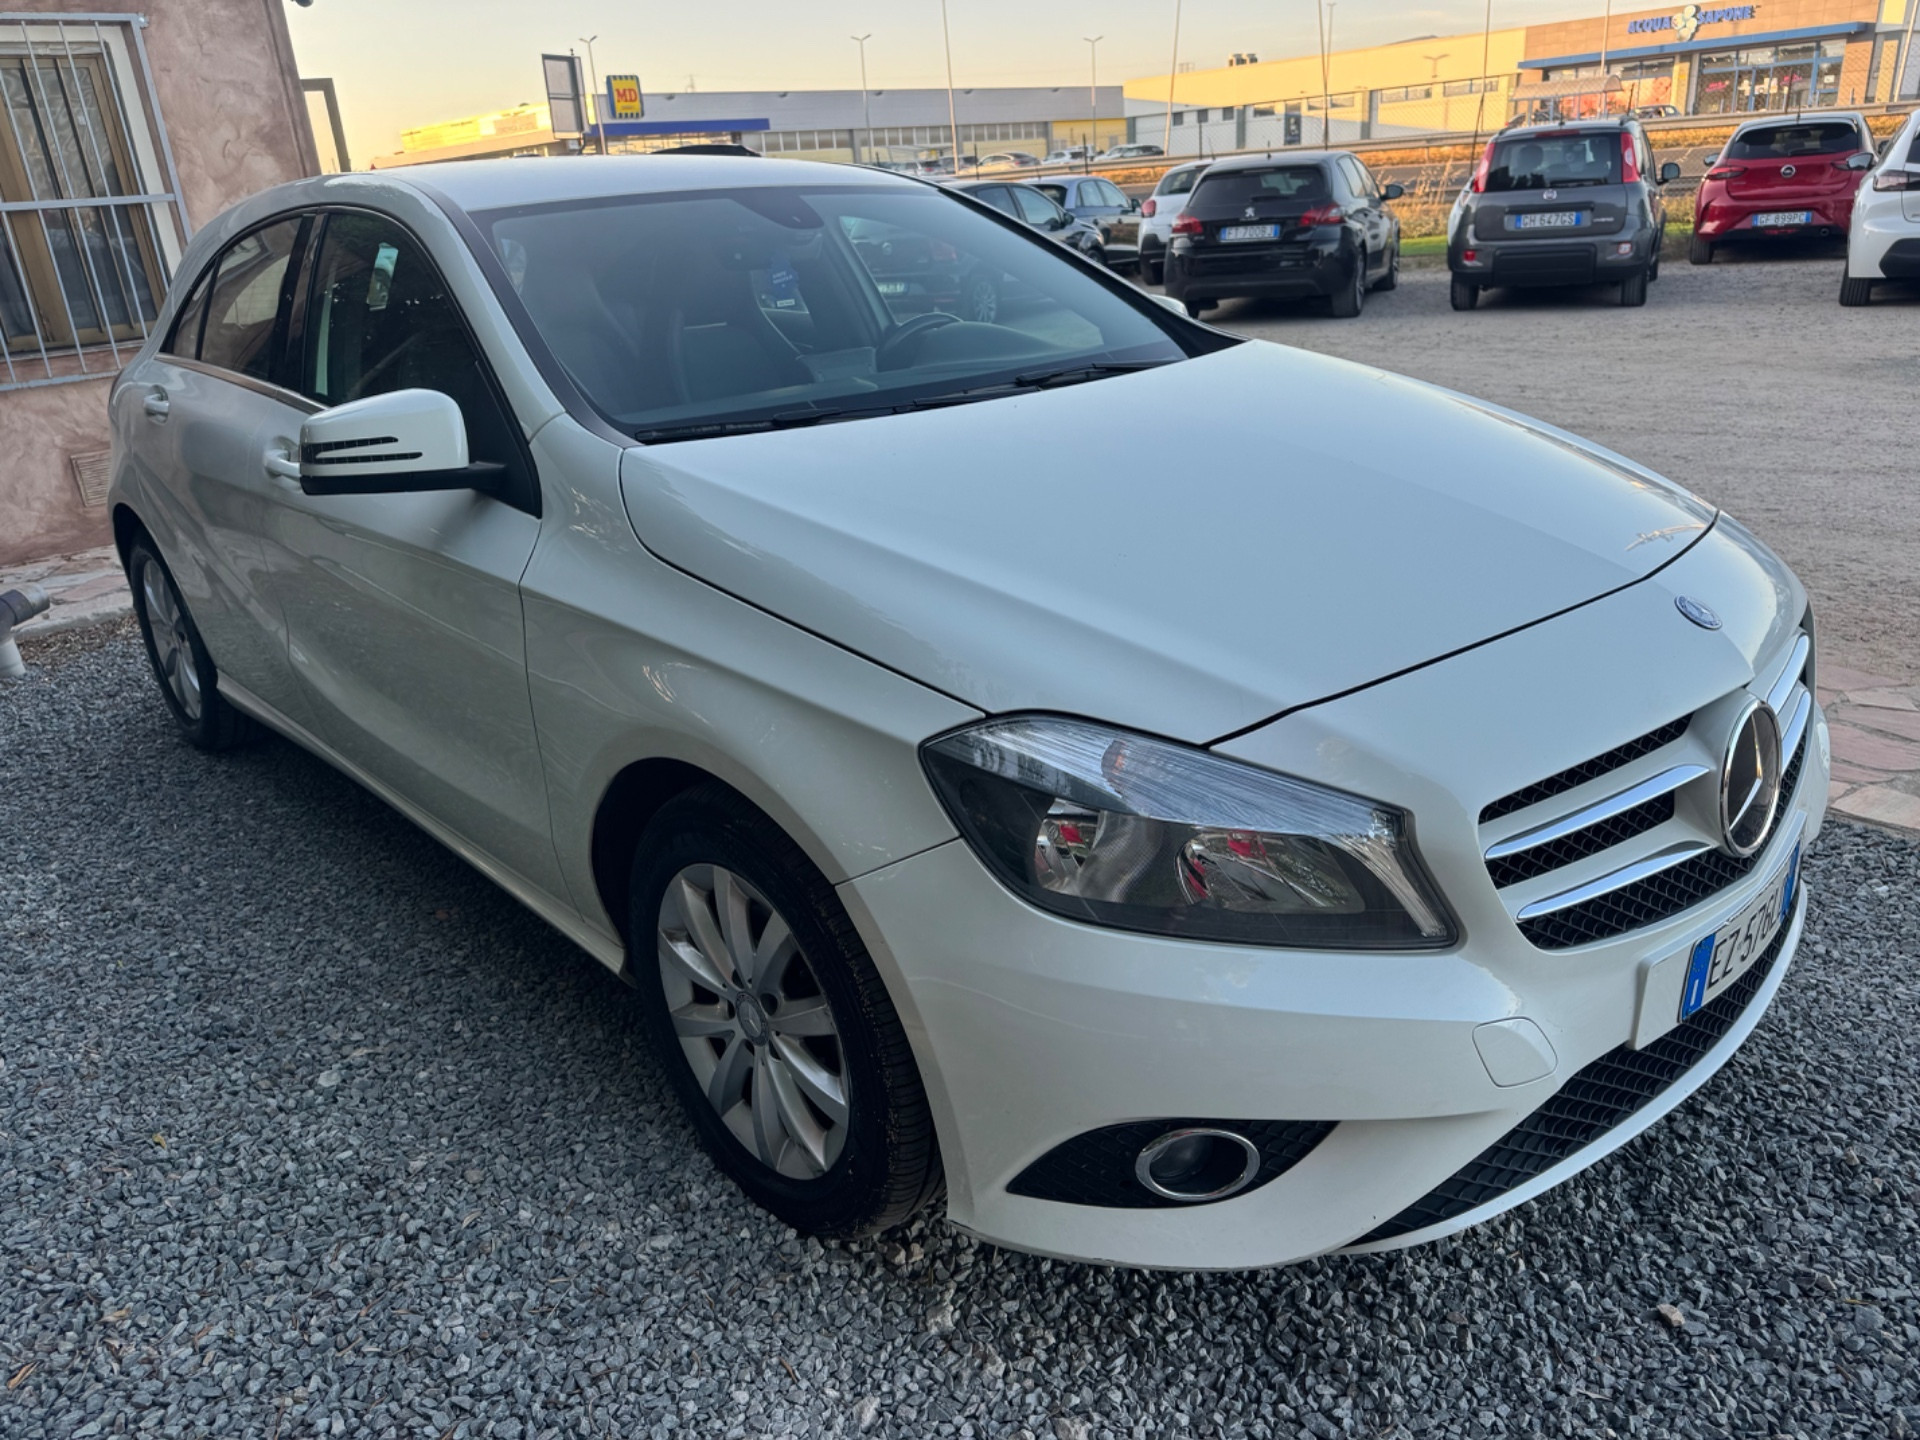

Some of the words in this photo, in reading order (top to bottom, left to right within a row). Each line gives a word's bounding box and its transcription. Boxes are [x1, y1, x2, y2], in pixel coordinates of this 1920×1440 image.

[1628, 16, 1671, 33] ACQUA
[1697, 5, 1754, 25] SAPONE
[615, 88, 638, 103] MD
